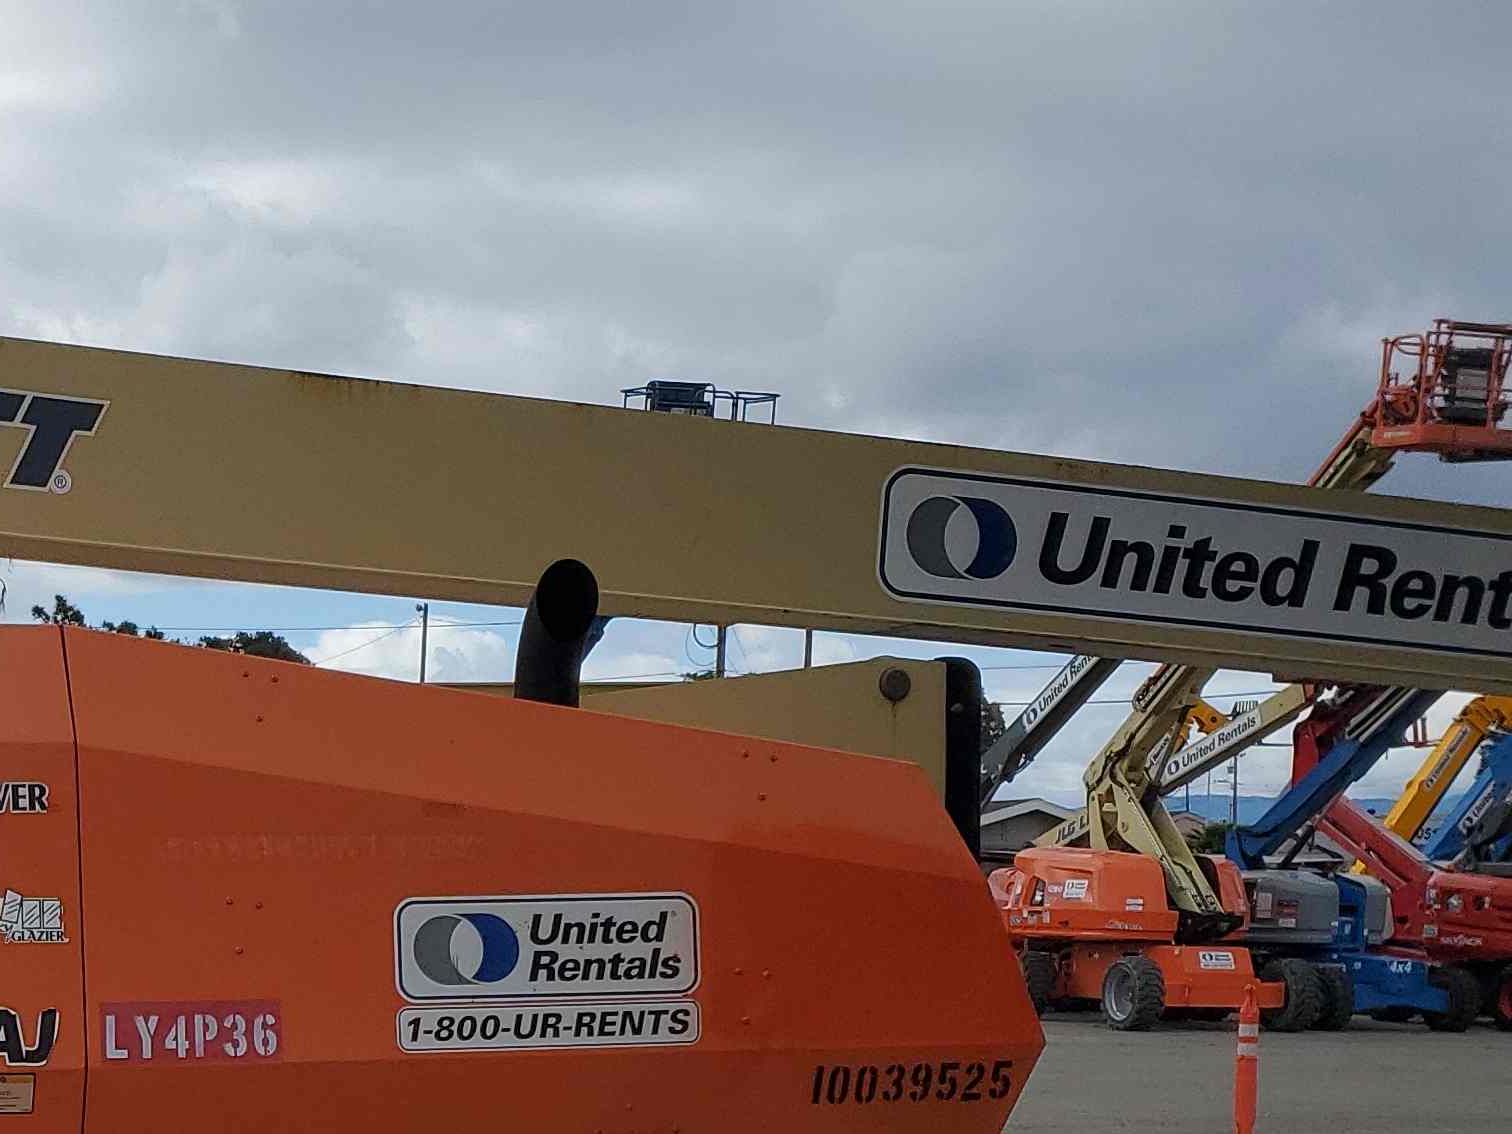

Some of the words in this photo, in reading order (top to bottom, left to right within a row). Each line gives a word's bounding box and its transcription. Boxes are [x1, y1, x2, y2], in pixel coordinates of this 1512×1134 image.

[1037, 511, 1321, 607] United
[1039, 674, 1068, 711] United
[1181, 738, 1216, 768] United
[1217, 714, 1257, 747] Rentals
[11, 930, 66, 943] GLAZIER
[528, 911, 669, 945] United
[528, 948, 682, 983] Rentals
[105, 1013, 278, 1059] LY4P36
[406, 1008, 691, 1042] 1-800-UR-RENTS
[810, 1060, 1014, 1104] 10039525
